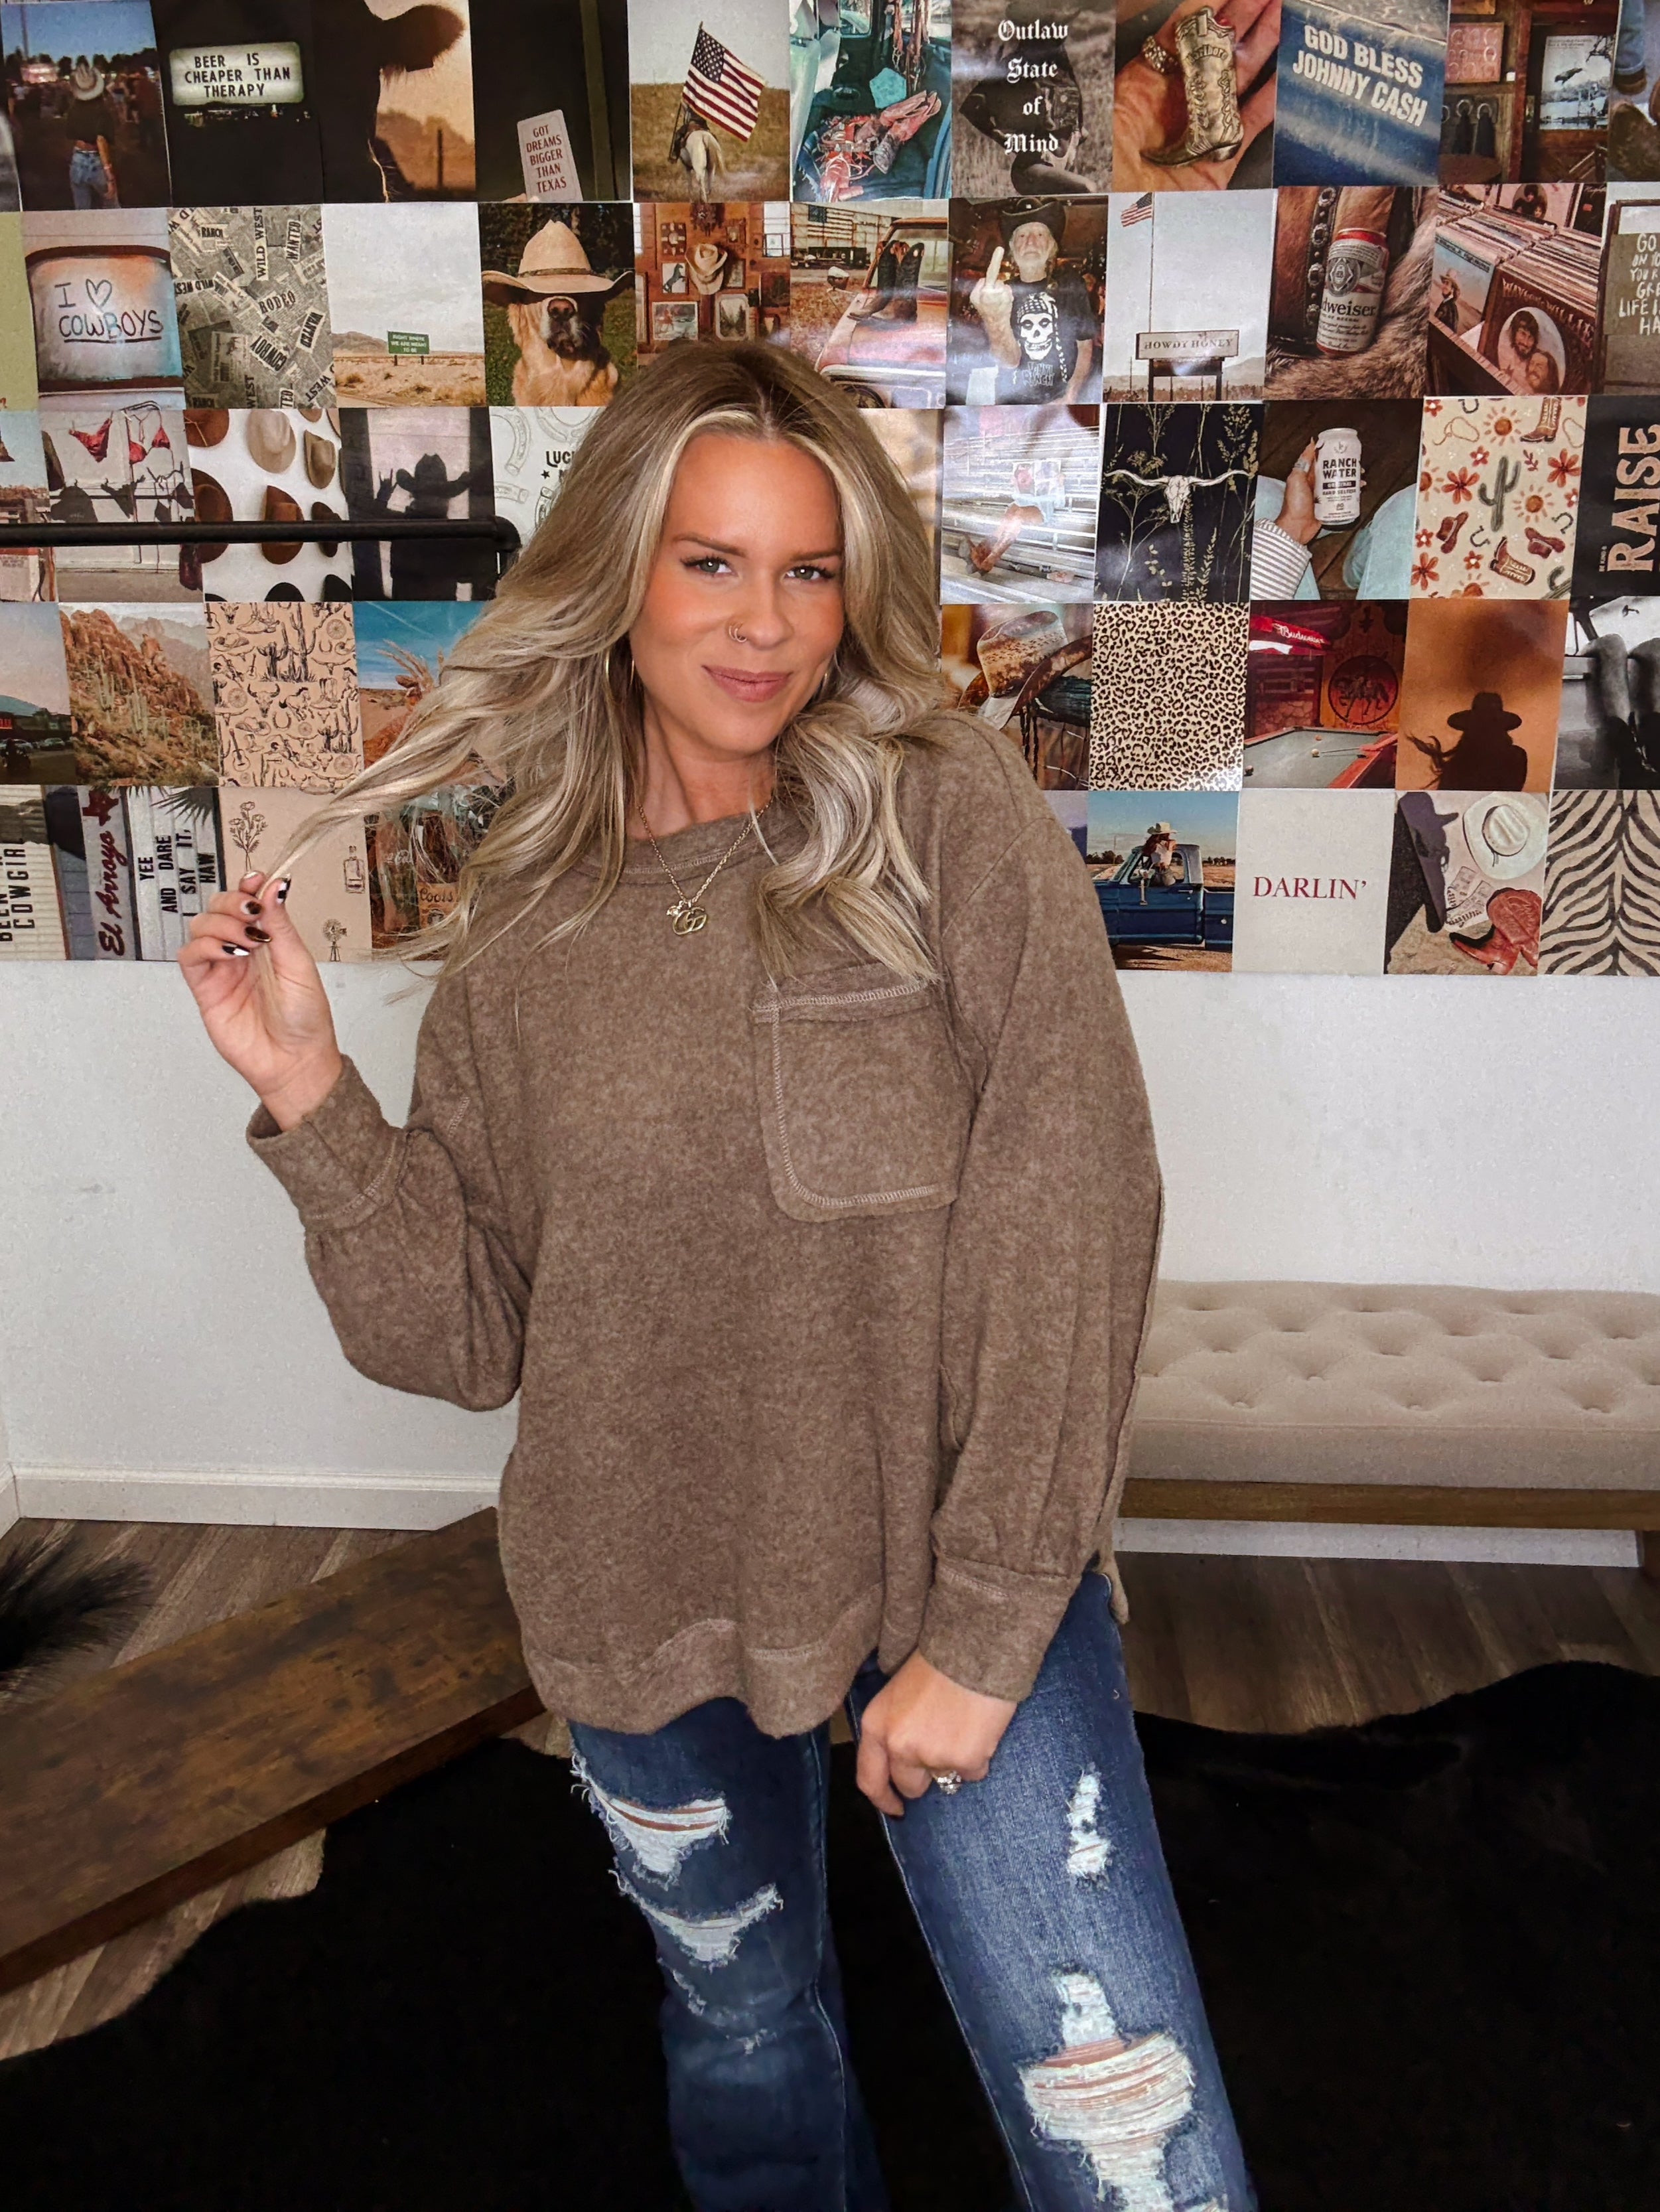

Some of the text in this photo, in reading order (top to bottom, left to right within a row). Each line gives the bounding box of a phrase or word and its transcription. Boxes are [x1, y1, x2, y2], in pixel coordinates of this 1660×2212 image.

[998, 19, 1068, 41] Outlaw
[194, 53, 259, 68] BEER IS
[1304, 25, 1423, 89] GOD BLESS
[184, 67, 290, 84] CHEAPER THAN
[1006, 56, 1058, 84] State
[204, 83, 265, 98] THERAPY
[1292, 50, 1428, 127] JOHNNY CASH
[1022, 95, 1043, 115] of
[533, 125, 549, 137] GOT
[526, 135, 562, 153] DREAMS
[1004, 132, 1058, 155] Mind
[529, 148, 563, 165] BIGGER
[535, 163, 561, 178] THAN
[536, 176, 567, 193] TEXAS
[253, 207, 266, 278] WILD WEST
[286, 221, 301, 259] WANTED
[1637, 233, 1657, 252] GO
[1632, 254, 1648, 267] ON
[54, 282, 76, 308] I
[258, 290, 296, 314] RODEO
[1619, 297, 1648, 317] LIFE
[58, 309, 164, 339] COWBOYS
[300, 312, 323, 348] WANTED
[249, 335, 287, 371] COWBOY
[1144, 338, 1233, 349] HOWDY HONEY
[546, 451, 574, 468] LUC
[1323, 458, 1357, 469] RANCH
[1323, 469, 1356, 479] WATER
[1607, 423, 1660, 571] RAISE
[138, 856, 155, 880] YEE
[155, 835, 178, 913] AND DARE
[198, 852, 216, 883] HAW
[179, 867, 196, 894] SAY
[1253, 876, 1367, 899] DARLIN’
[96, 830, 127, 956] El Arroyo
